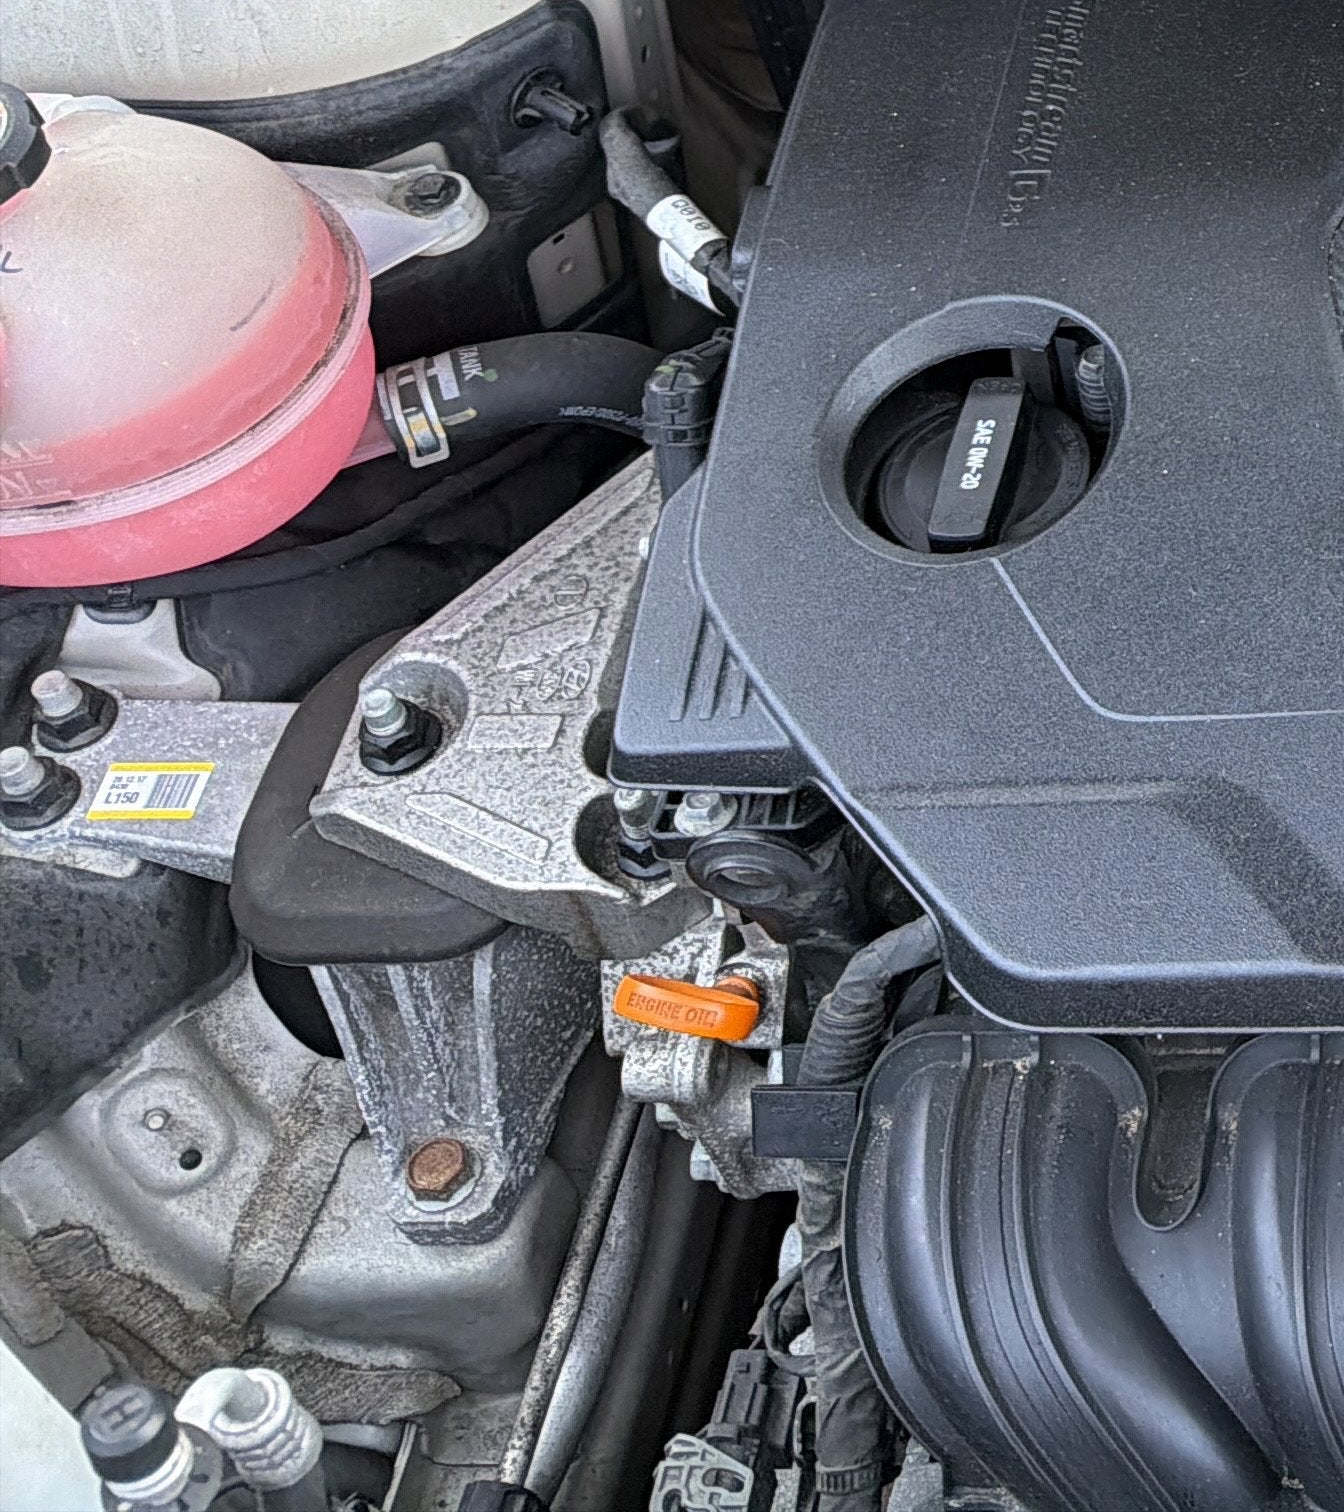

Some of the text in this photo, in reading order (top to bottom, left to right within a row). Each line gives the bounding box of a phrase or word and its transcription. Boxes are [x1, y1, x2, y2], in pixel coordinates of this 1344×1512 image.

[971, 419, 996, 445] SAE
[960, 447, 989, 490] 0W-20
[104, 792, 140, 804] L150
[626, 991, 683, 1020] ENGINE
